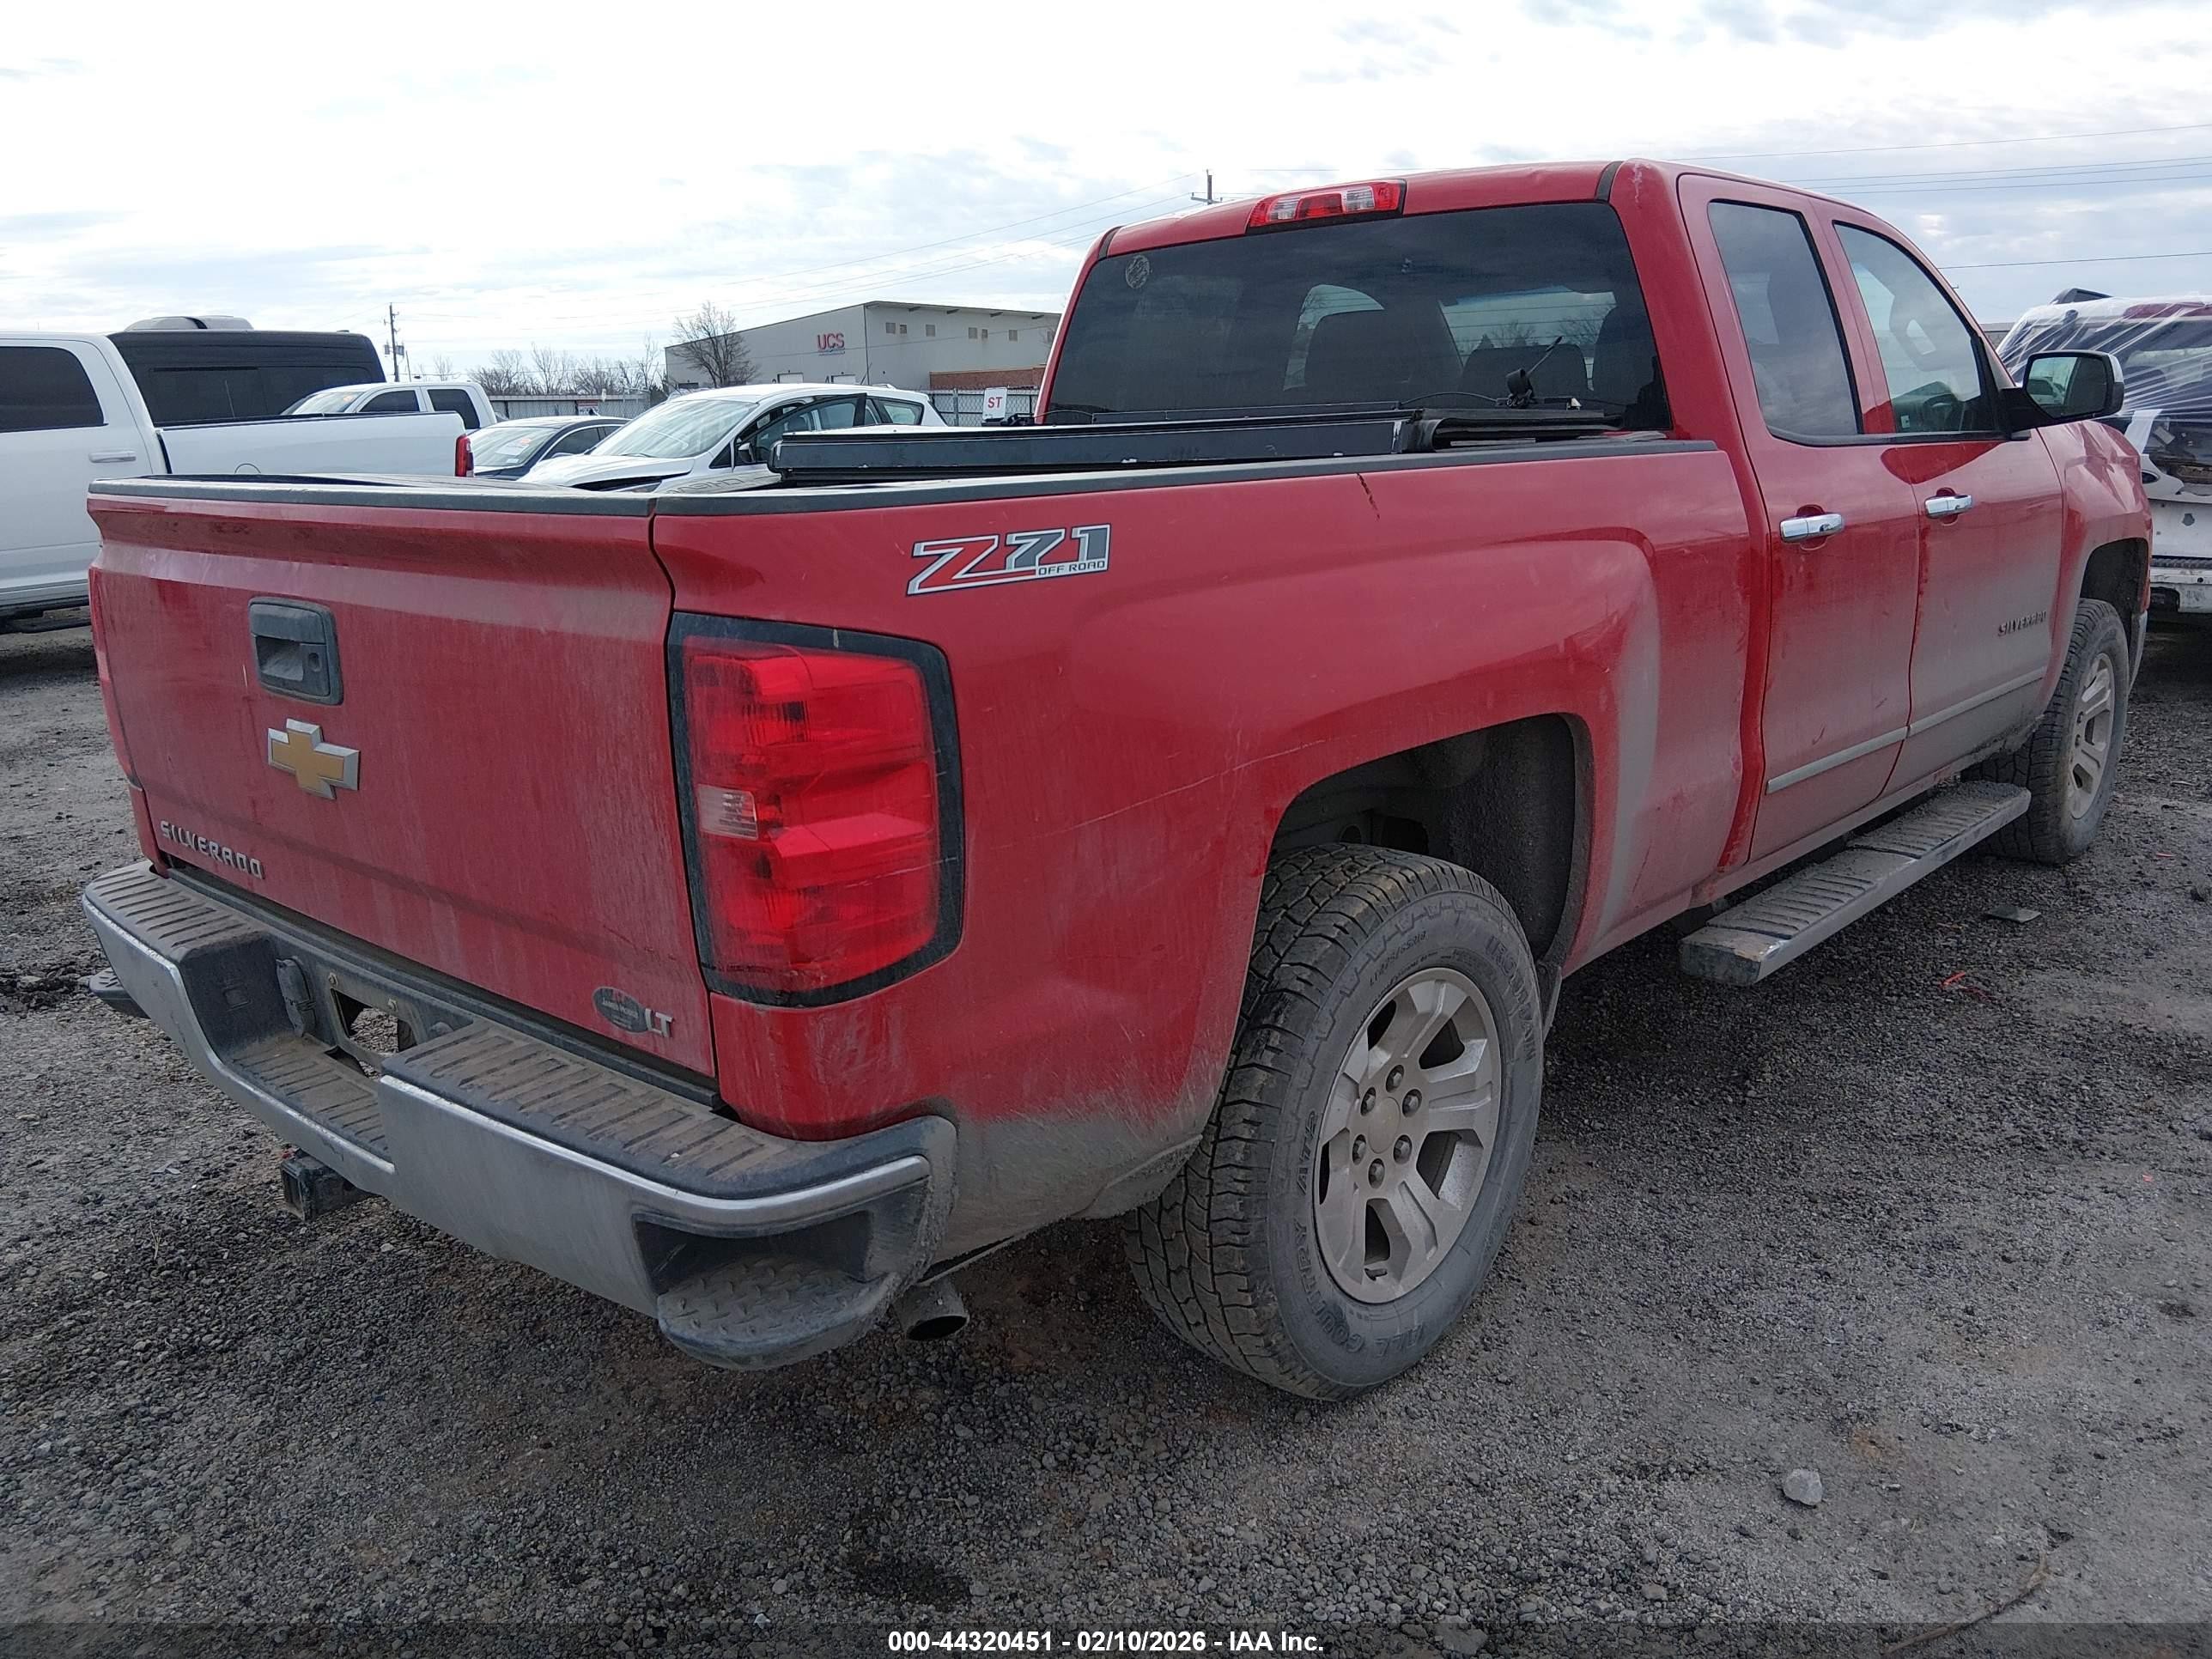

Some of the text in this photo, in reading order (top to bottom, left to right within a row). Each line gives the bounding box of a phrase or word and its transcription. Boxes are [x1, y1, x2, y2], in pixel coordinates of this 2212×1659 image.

[817, 332, 845, 350] UCS
[988, 396, 1003, 409] ST
[906, 524, 1111, 597] Z71
[1037, 560, 1106, 576] OFF ROAD
[160, 820, 265, 880] SILVERADO
[645, 1007, 674, 1038] LT
